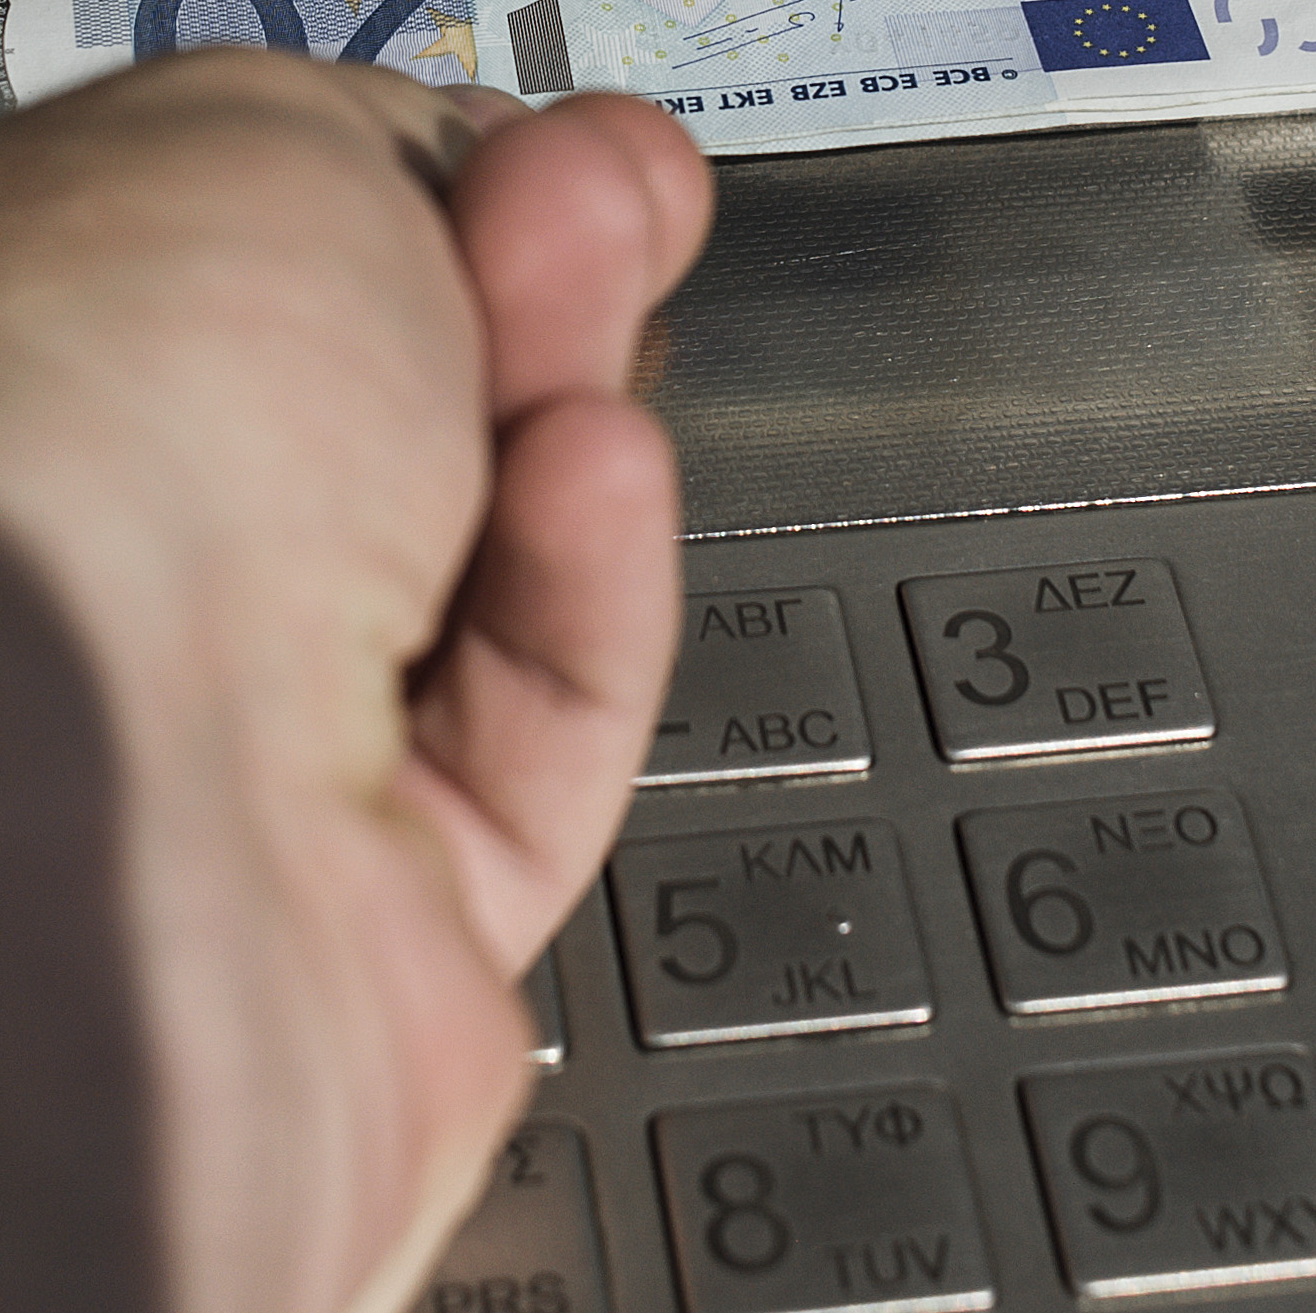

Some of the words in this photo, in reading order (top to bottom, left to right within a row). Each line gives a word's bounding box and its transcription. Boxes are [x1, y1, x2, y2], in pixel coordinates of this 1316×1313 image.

[790, 80, 848, 102] EZB
[859, 73, 919, 94] ECB
[932, 66, 992, 87] BCE
[655, 95, 705, 116] EK
[1033, 568, 1147, 615] ΔΕΖ
[942, 609, 1032, 707] 3
[1055, 678, 1171, 726] DEF
[720, 708, 839, 756] ABC
[1002, 848, 1096, 958] 6
[654, 877, 738, 986] 5
[1122, 922, 1266, 981] MNO
[771, 957, 876, 1010] JKL
[1067, 1114, 1163, 1234] 9
[698, 1152, 792, 1274] 8
[830, 1232, 952, 1295] TUV
